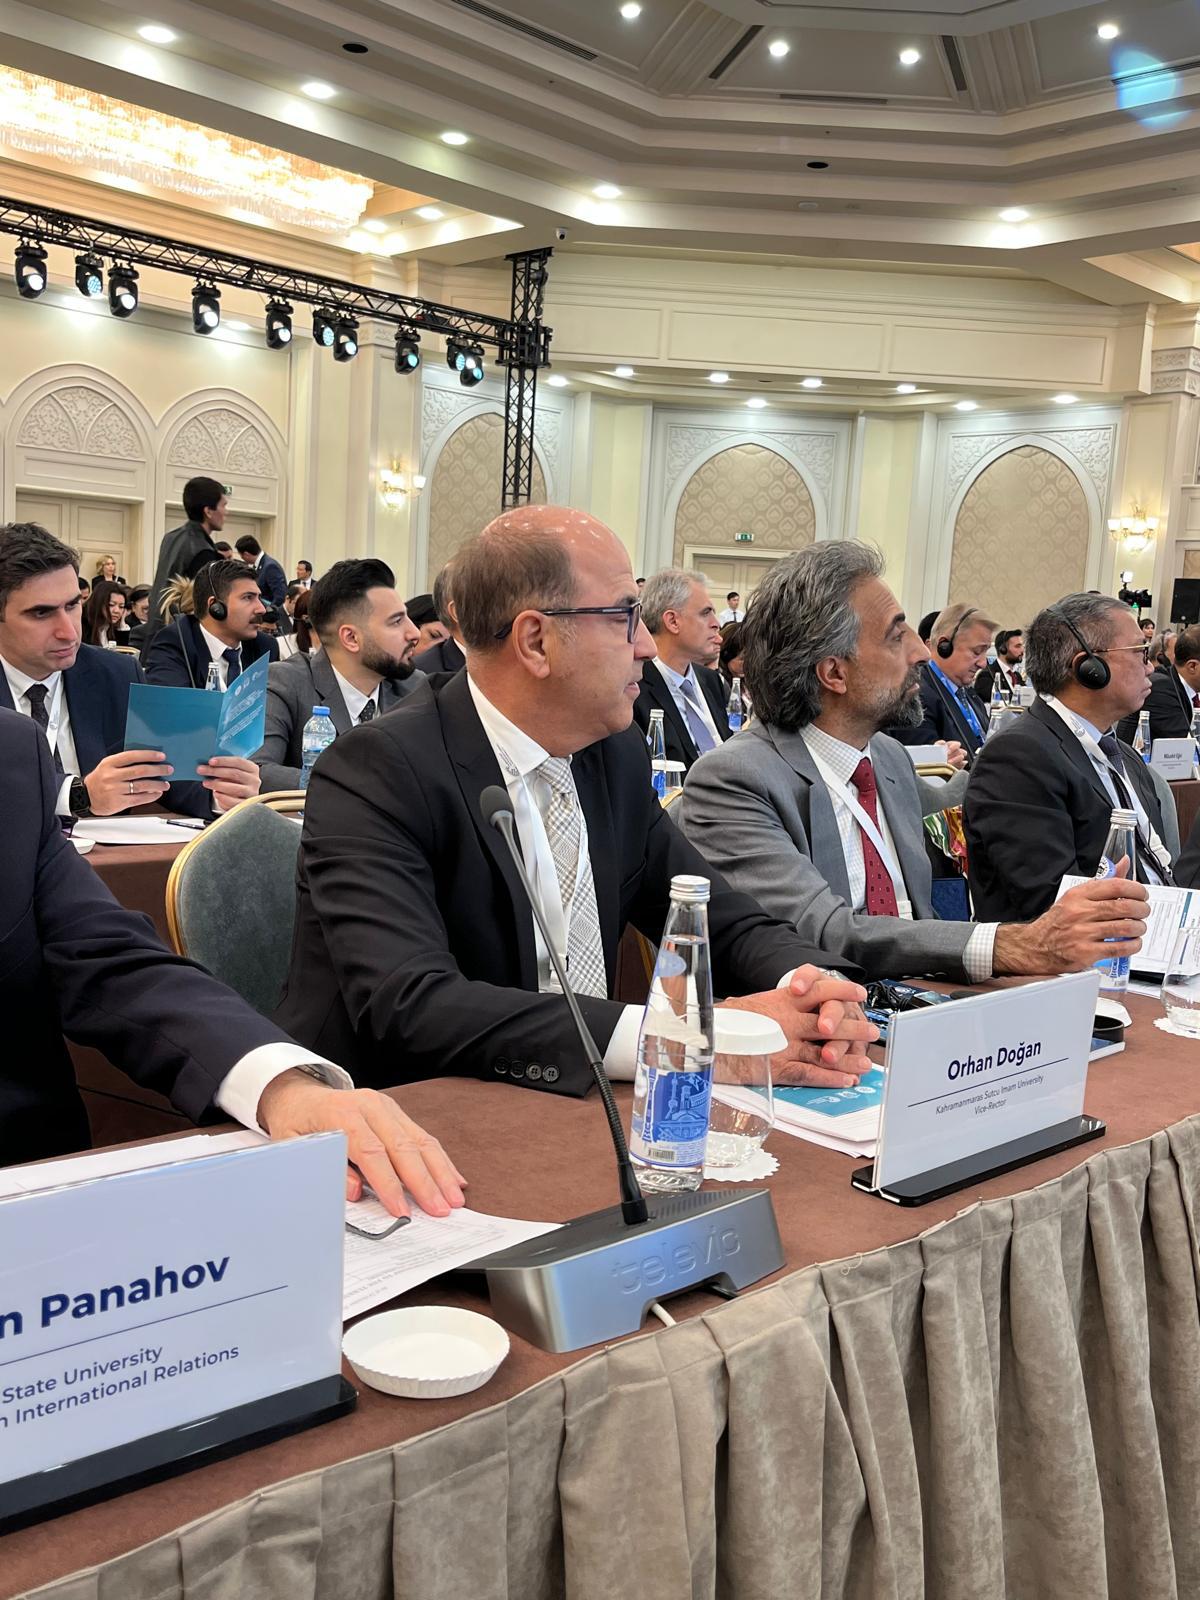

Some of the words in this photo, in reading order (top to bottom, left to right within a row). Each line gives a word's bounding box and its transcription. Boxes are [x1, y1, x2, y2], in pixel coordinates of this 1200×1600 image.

[947, 1055, 993, 1080] Orhan
[997, 1041, 1041, 1066] Doğan
[1001, 1083, 1017, 1094] Imam
[1017, 1075, 1044, 1089] University
[974, 1099, 1007, 1115] Vice-Rector
[41, 1256, 230, 1328] Panahov
[2, 1378, 57, 1405] State
[64, 1347, 163, 1386] University
[16, 1371, 147, 1425] International
[154, 1347, 239, 1382] Relations
